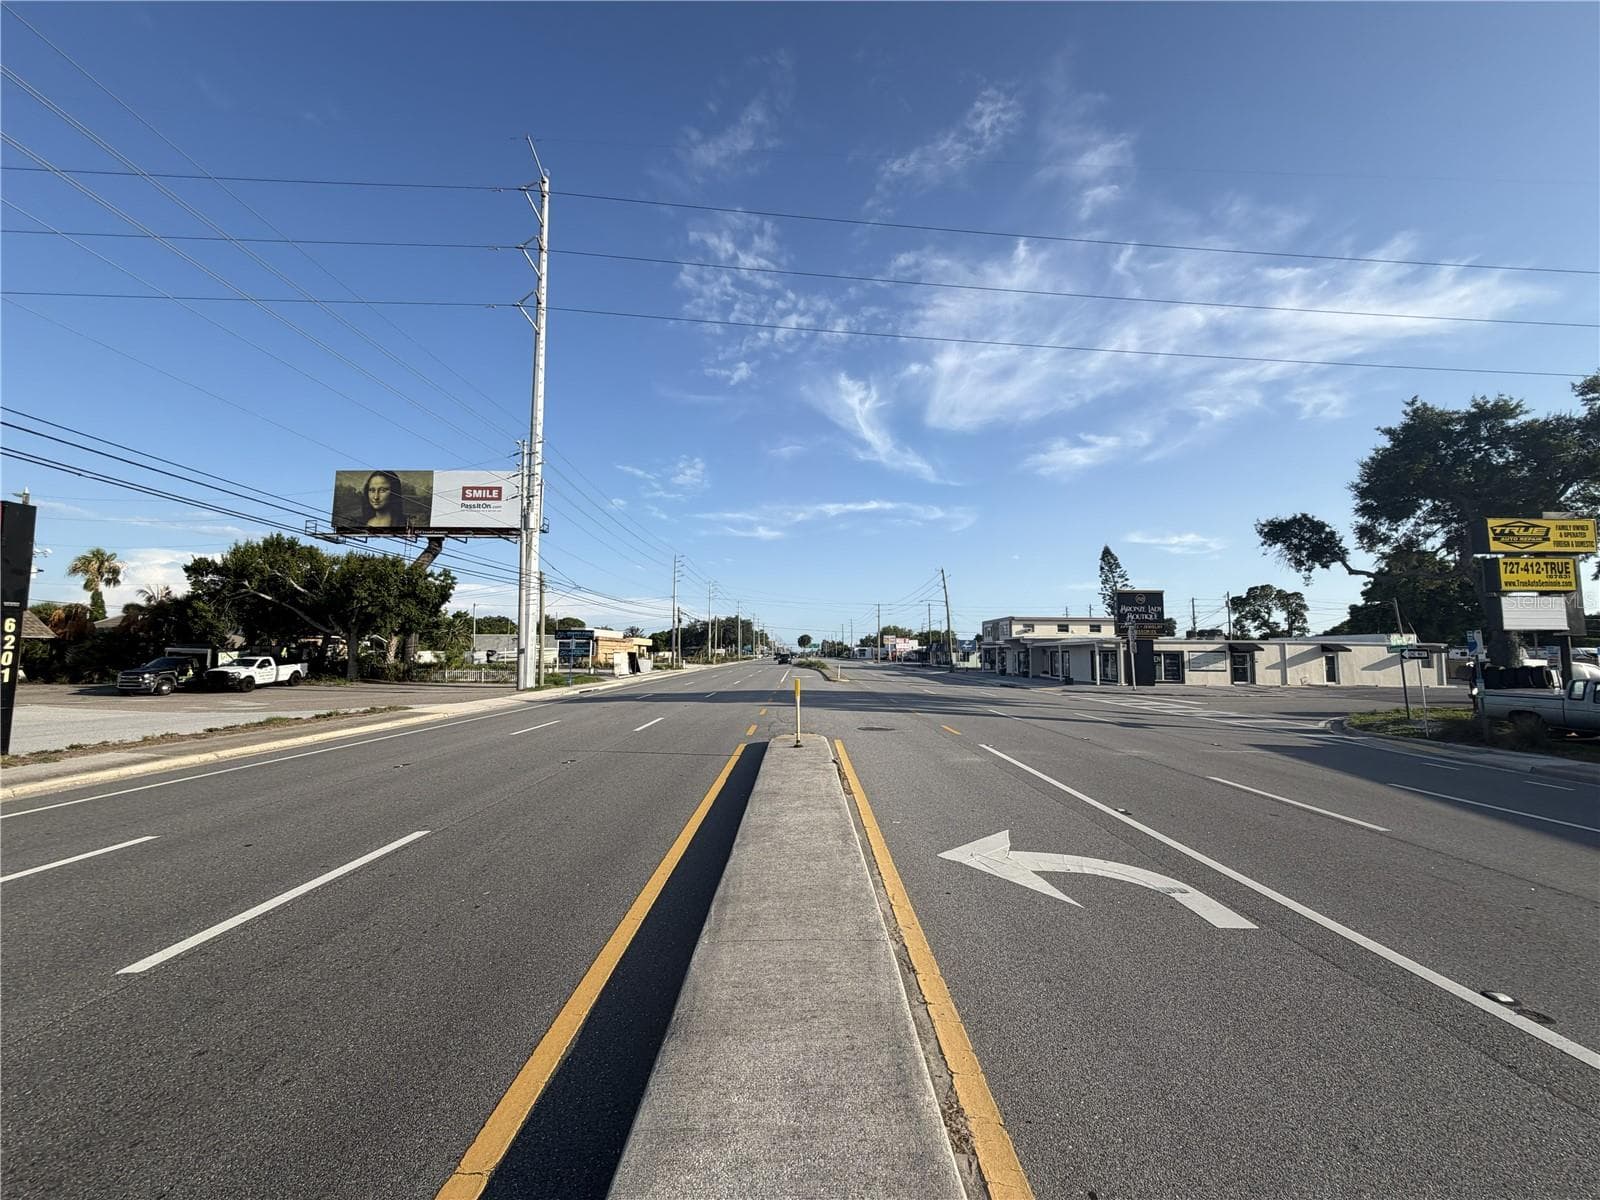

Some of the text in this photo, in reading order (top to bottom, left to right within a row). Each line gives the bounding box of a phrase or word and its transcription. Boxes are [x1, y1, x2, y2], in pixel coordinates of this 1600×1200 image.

[465, 489, 499, 498] SMILE
[1493, 526, 1546, 535] TRUE
[1503, 561, 1571, 575] 727-412-TRUE
[1, 617, 17, 683] 6201
